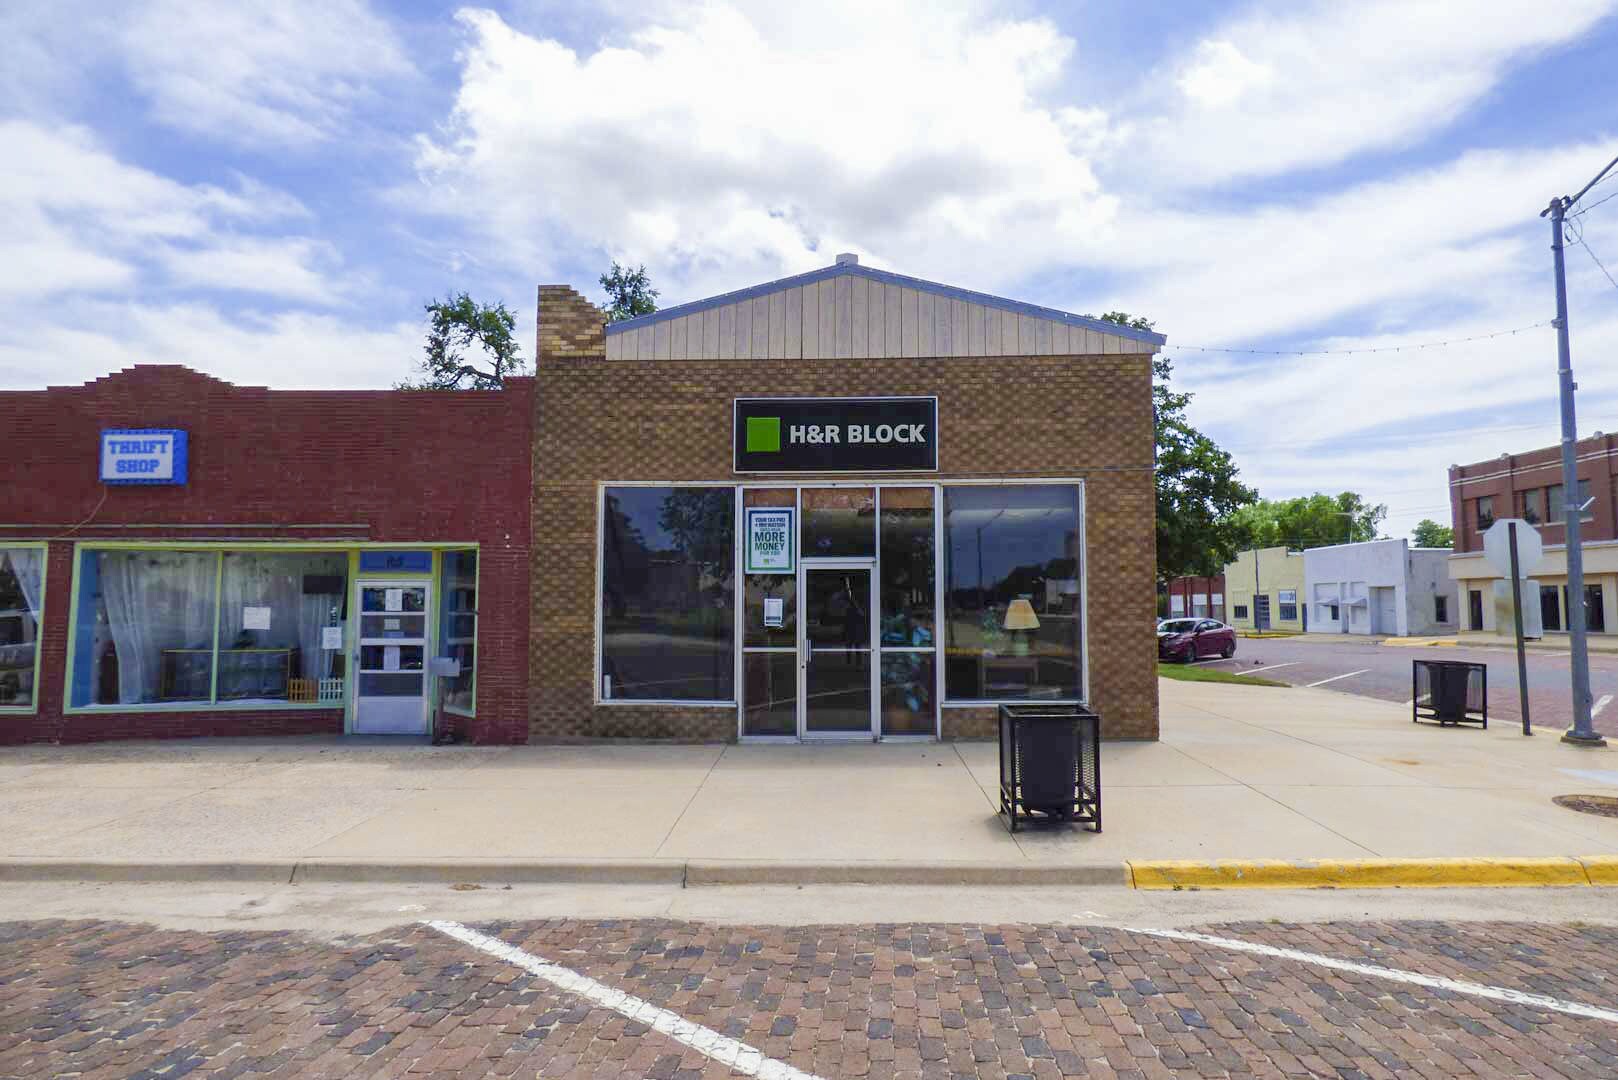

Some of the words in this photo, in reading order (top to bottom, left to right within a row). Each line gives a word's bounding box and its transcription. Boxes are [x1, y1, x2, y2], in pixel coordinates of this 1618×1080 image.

[790, 425, 840, 444] H&R
[848, 424, 926, 443] BLOCK
[108, 440, 169, 454] THRIFT
[115, 459, 160, 473] SHOP
[755, 532, 785, 542] MORE
[755, 542, 785, 551] MONEY
